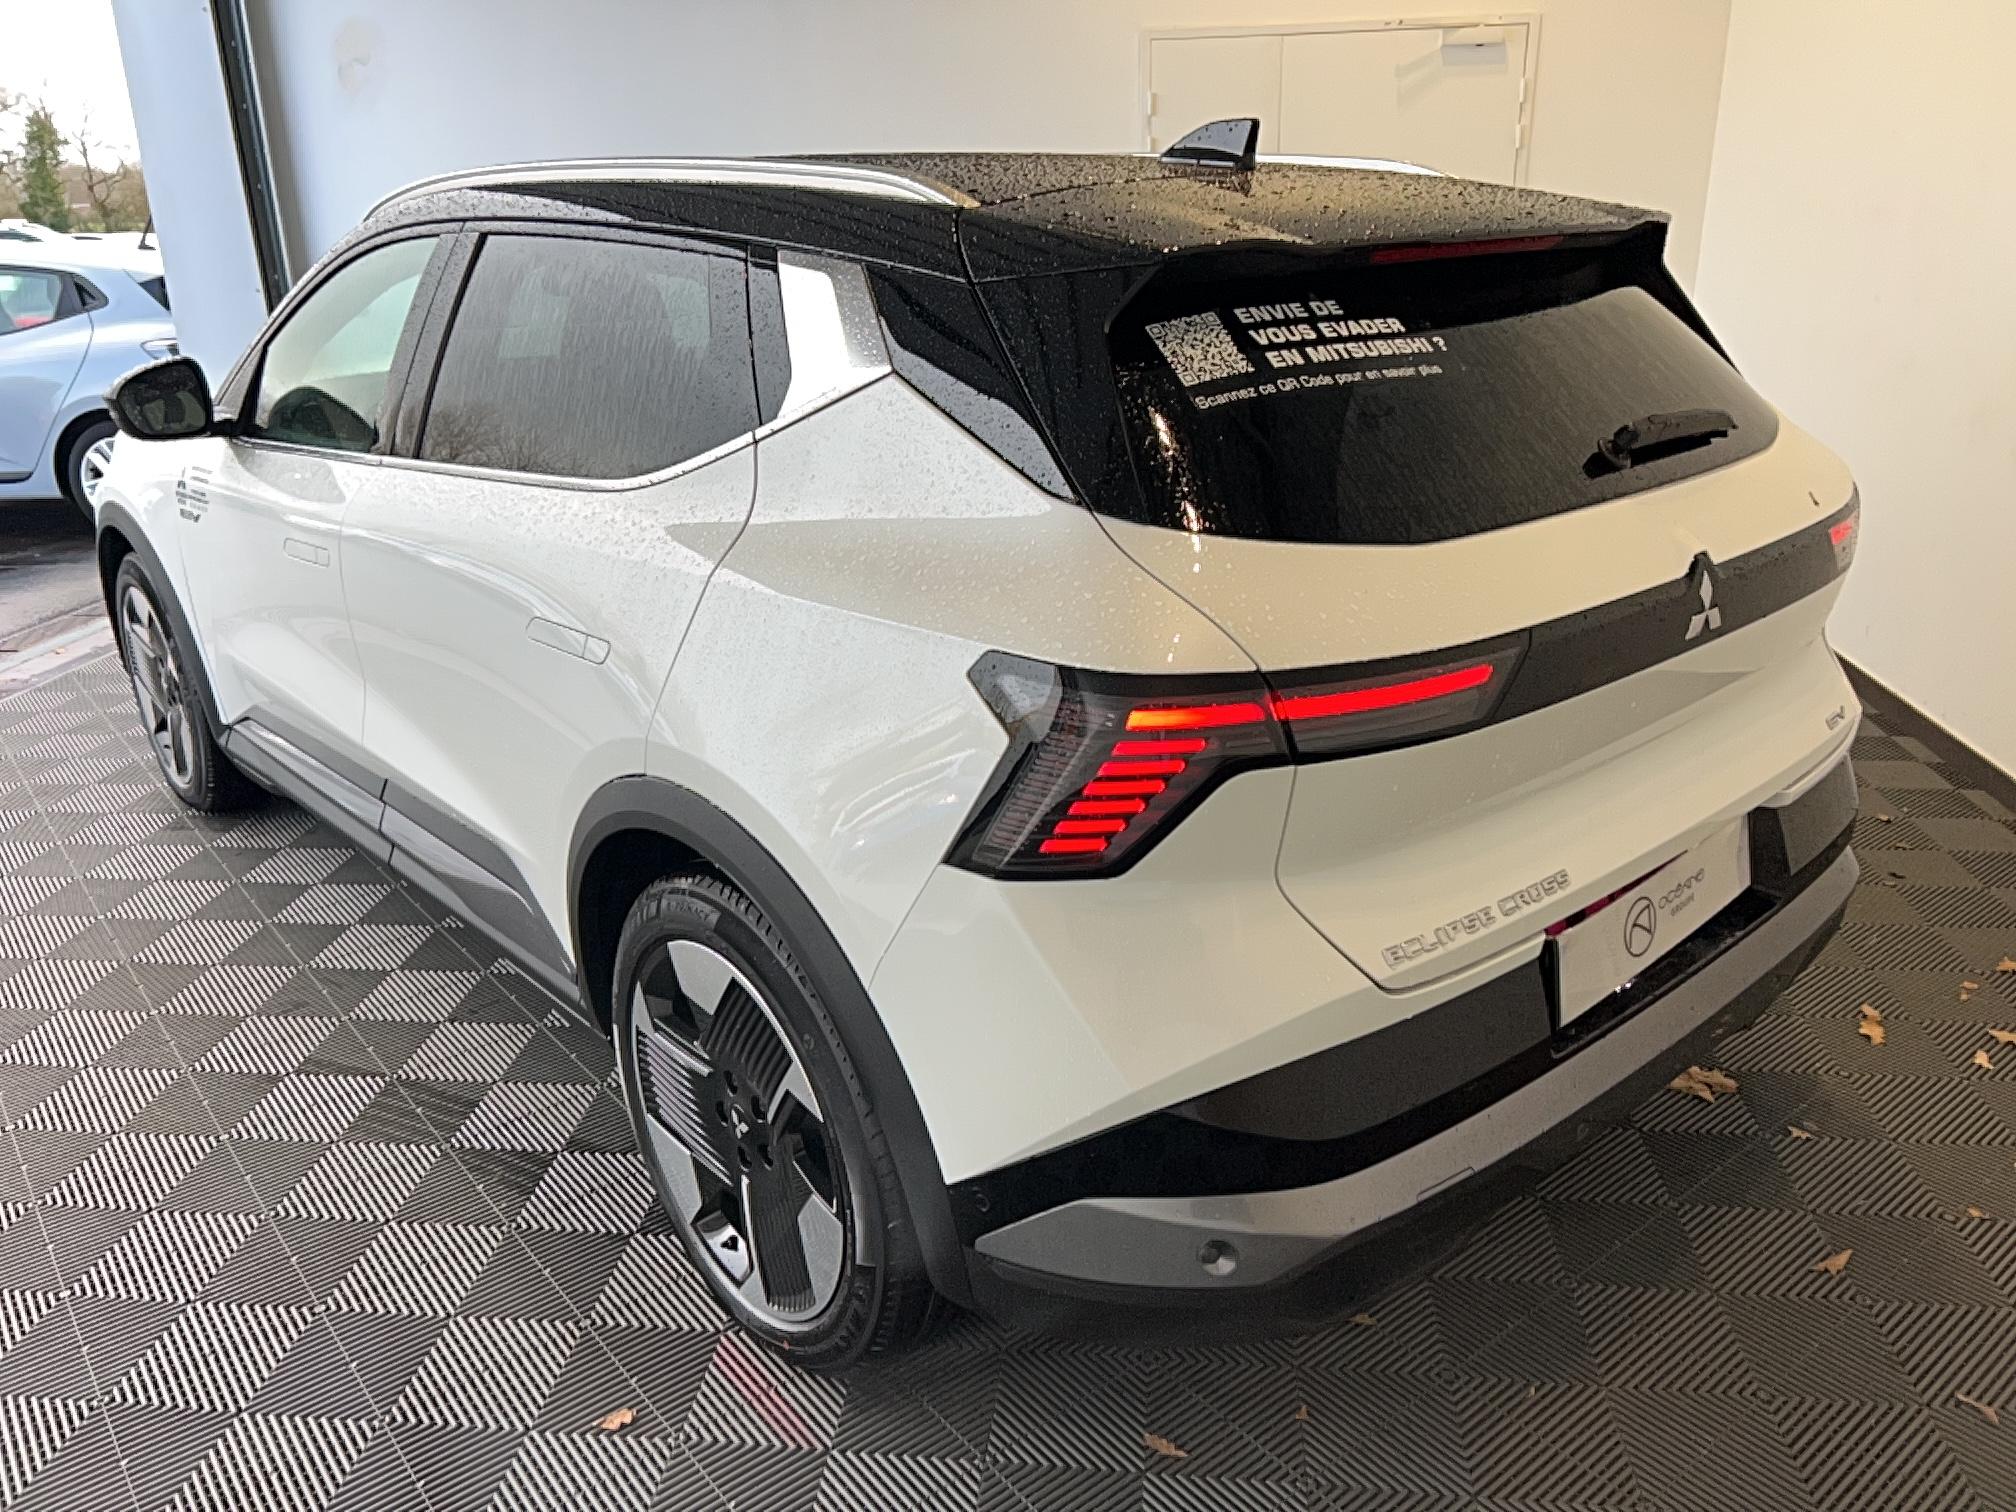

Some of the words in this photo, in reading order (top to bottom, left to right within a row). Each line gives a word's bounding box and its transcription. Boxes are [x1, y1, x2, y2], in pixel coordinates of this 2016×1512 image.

[1233, 302, 1309, 324] ENVIE
[1308, 300, 1344, 316] DE
[1248, 323, 1317, 346] VOUS
[1317, 317, 1407, 338] EVADER
[1264, 348, 1305, 369] EN
[1304, 336, 1434, 364] MITSUBISHI
[1431, 335, 1448, 352] ?
[1194, 387, 1258, 410] Scannez
[1258, 383, 1277, 396] ce
[1277, 377, 1301, 392] QR
[1299, 374, 1335, 388] Code
[1334, 371, 1363, 387] pour
[1364, 369, 1383, 380] en
[1380, 905, 1498, 970] ECLIPSE
[1496, 867, 1572, 918] CROSS
